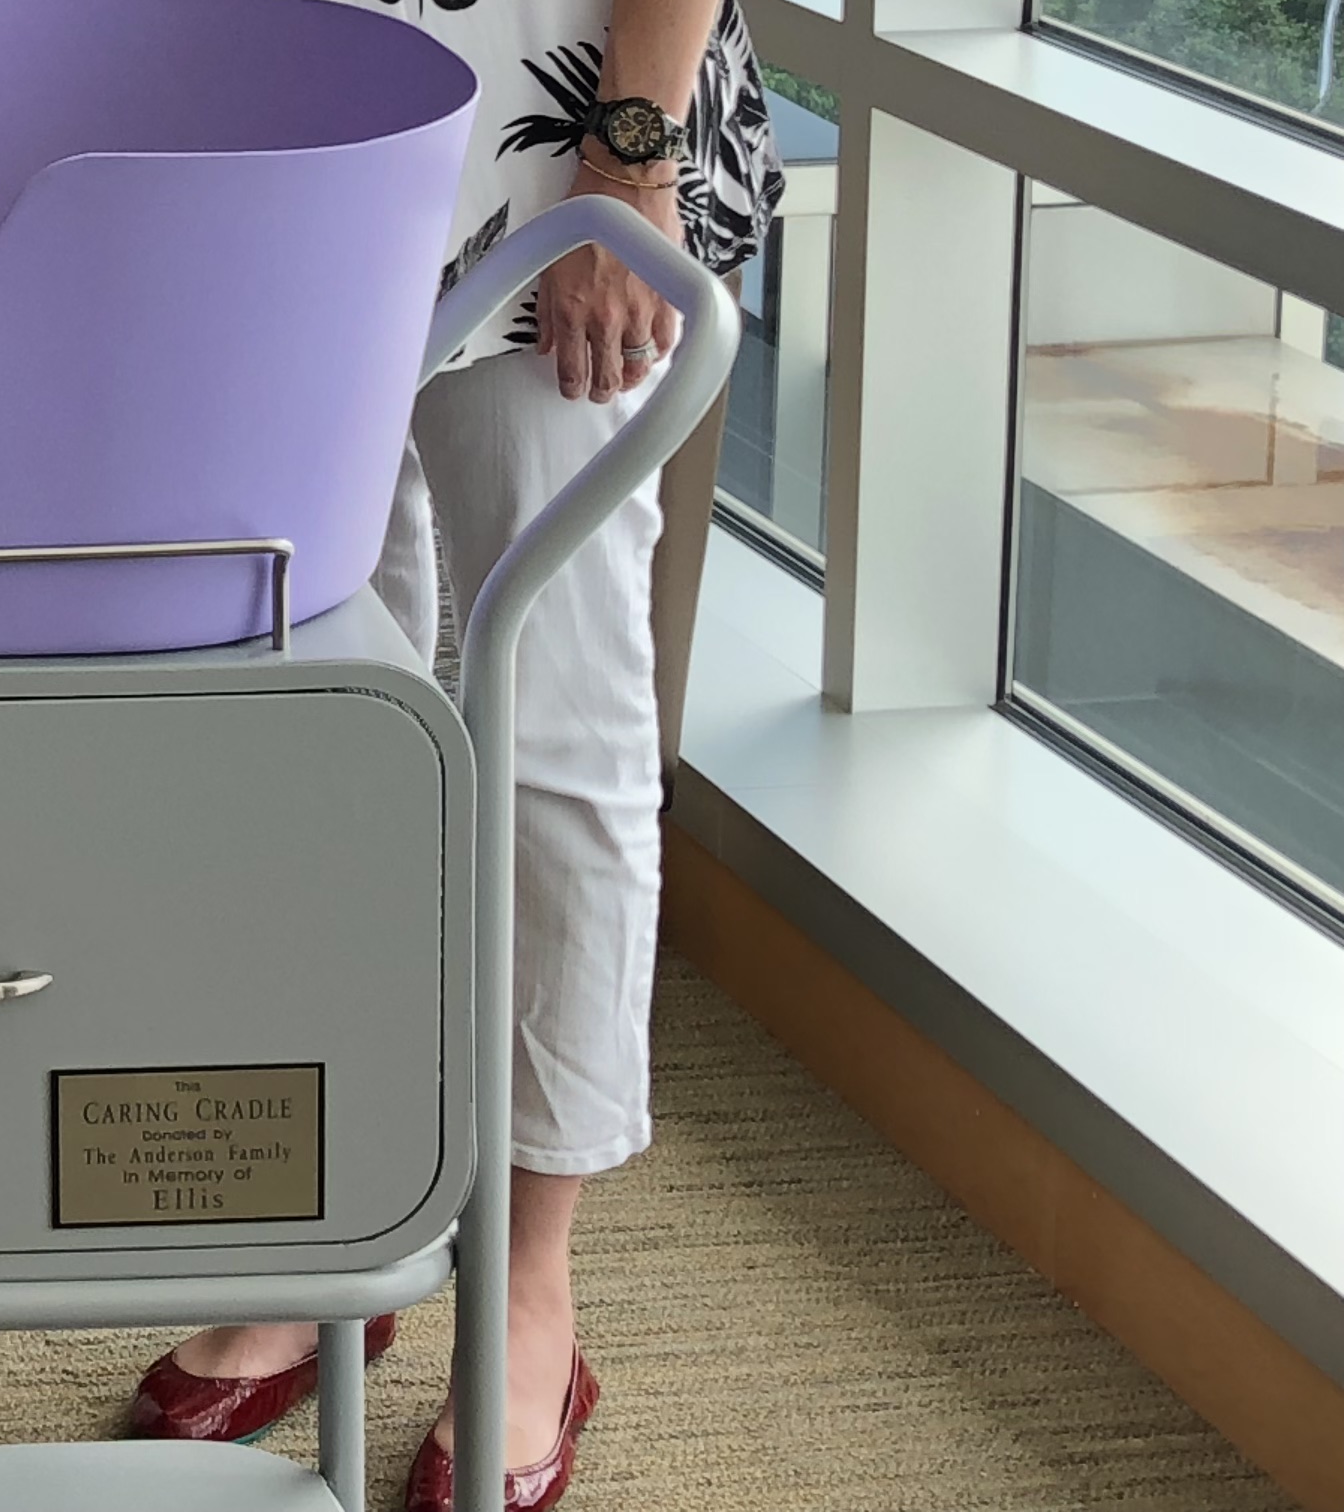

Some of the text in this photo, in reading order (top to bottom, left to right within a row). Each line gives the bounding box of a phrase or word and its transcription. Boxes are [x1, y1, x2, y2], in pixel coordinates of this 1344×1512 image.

[82, 1097, 293, 1125] CARING CRADLE
[142, 1129, 206, 1142] Donated
[83, 1142, 292, 1165] The Anderson Family
[122, 1166, 253, 1184] In Memory of
[152, 1189, 225, 1211] Ellis
